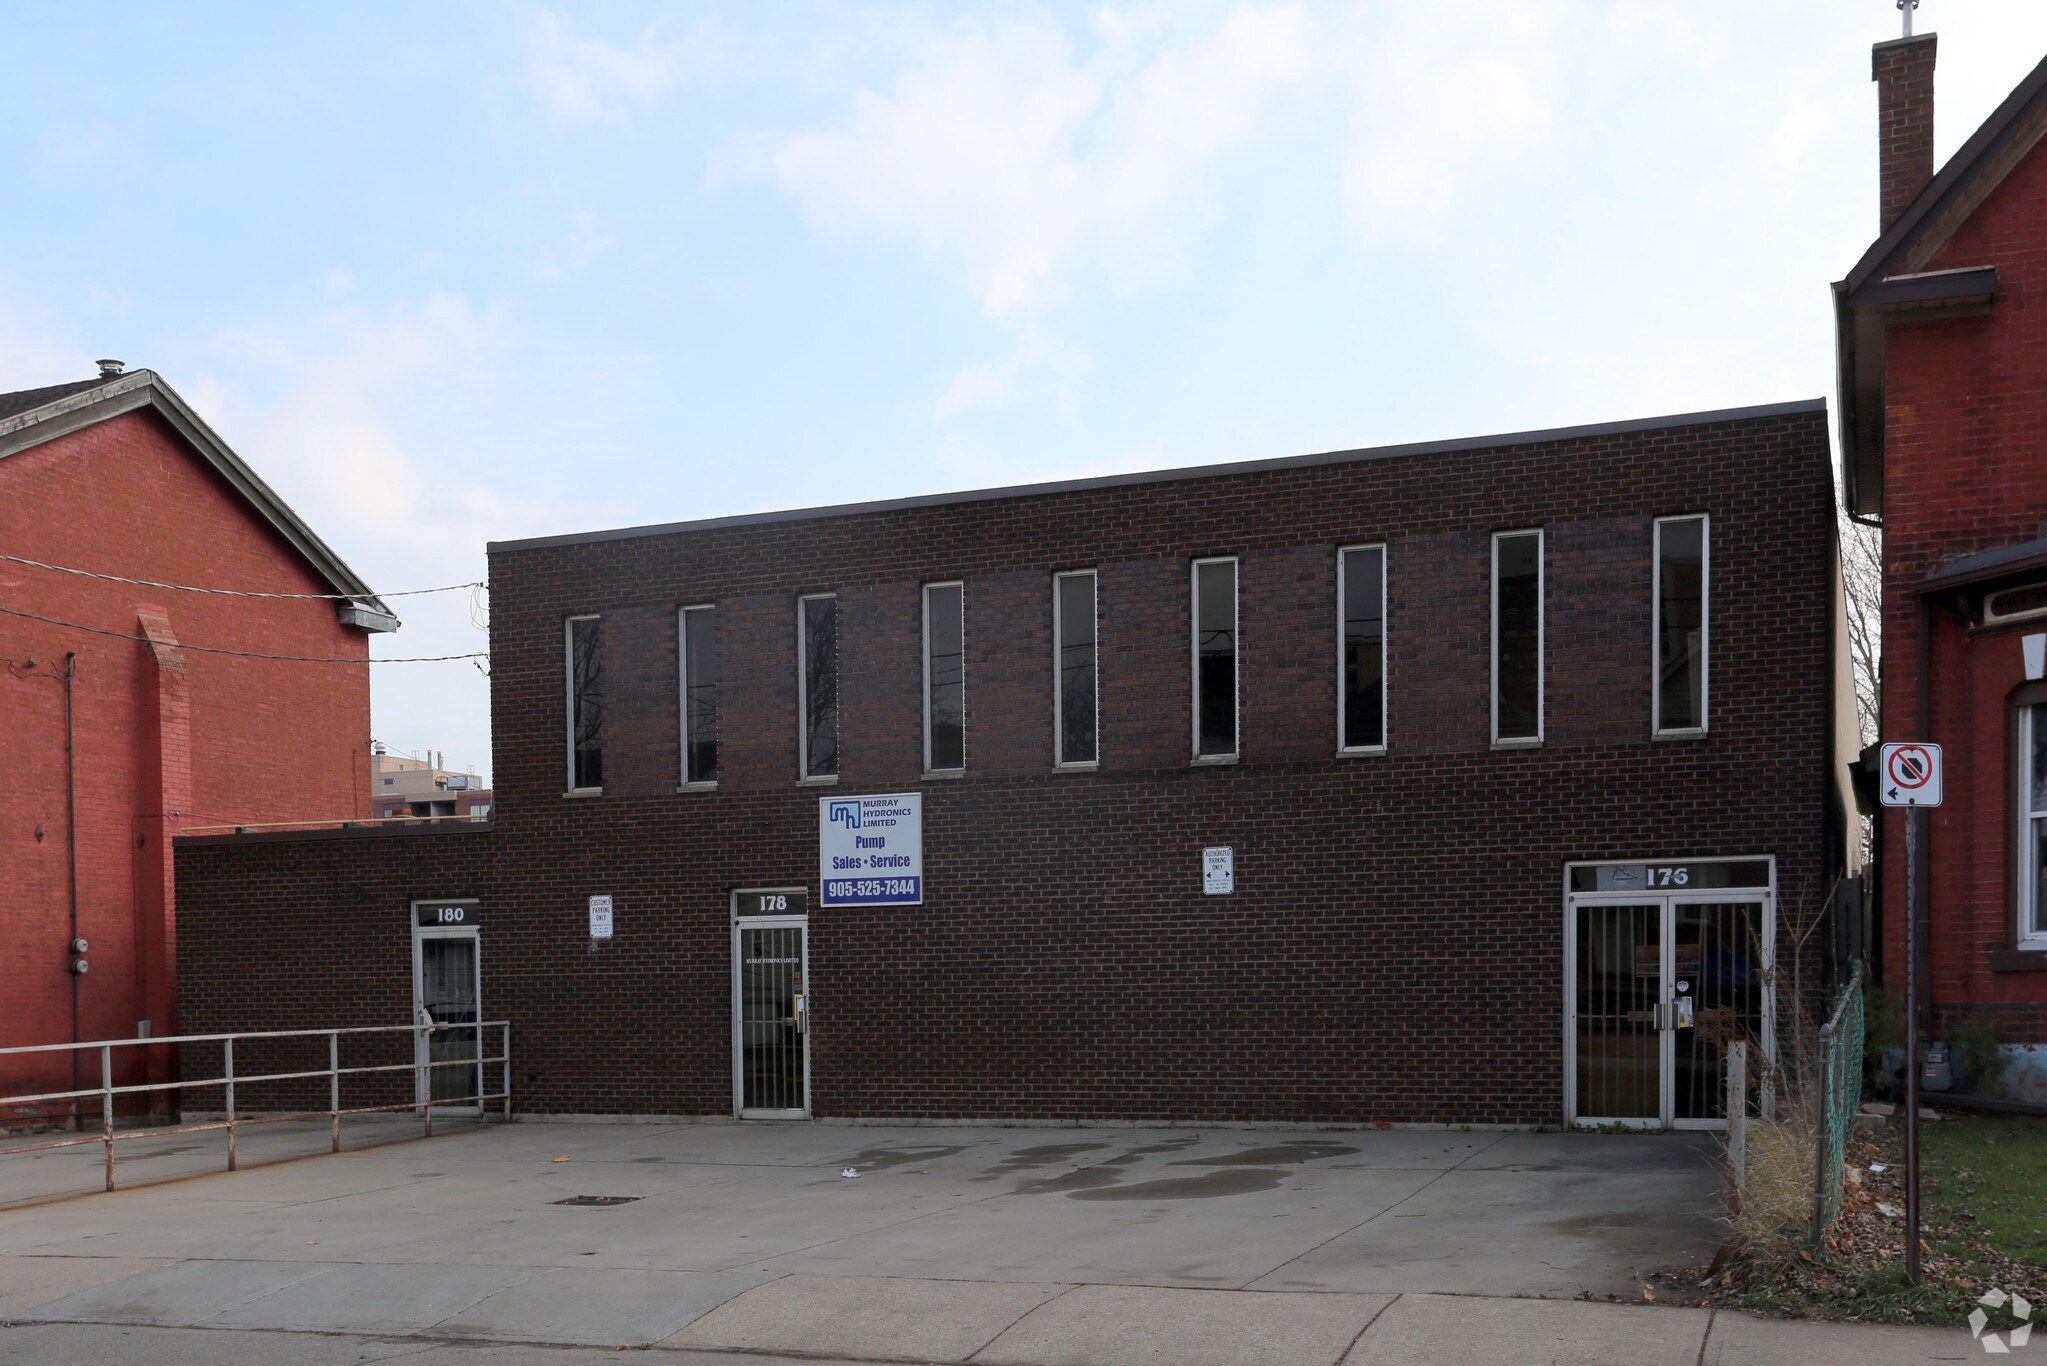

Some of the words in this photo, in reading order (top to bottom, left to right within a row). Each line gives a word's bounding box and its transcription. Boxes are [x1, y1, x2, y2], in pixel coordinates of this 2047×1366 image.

[863, 799, 899, 808] MURRAY
[863, 808, 911, 817] HYDRONICS
[863, 819, 896, 827] LIMITED
[856, 836, 885, 849] Pump
[833, 856, 861, 869] Sales
[870, 854, 910, 868] Service
[1647, 867, 1689, 886] 176
[829, 879, 915, 897] 905-525-7344
[592, 906, 610, 914] PARKING
[760, 895, 787, 911] 178
[438, 907, 464, 922] 180
